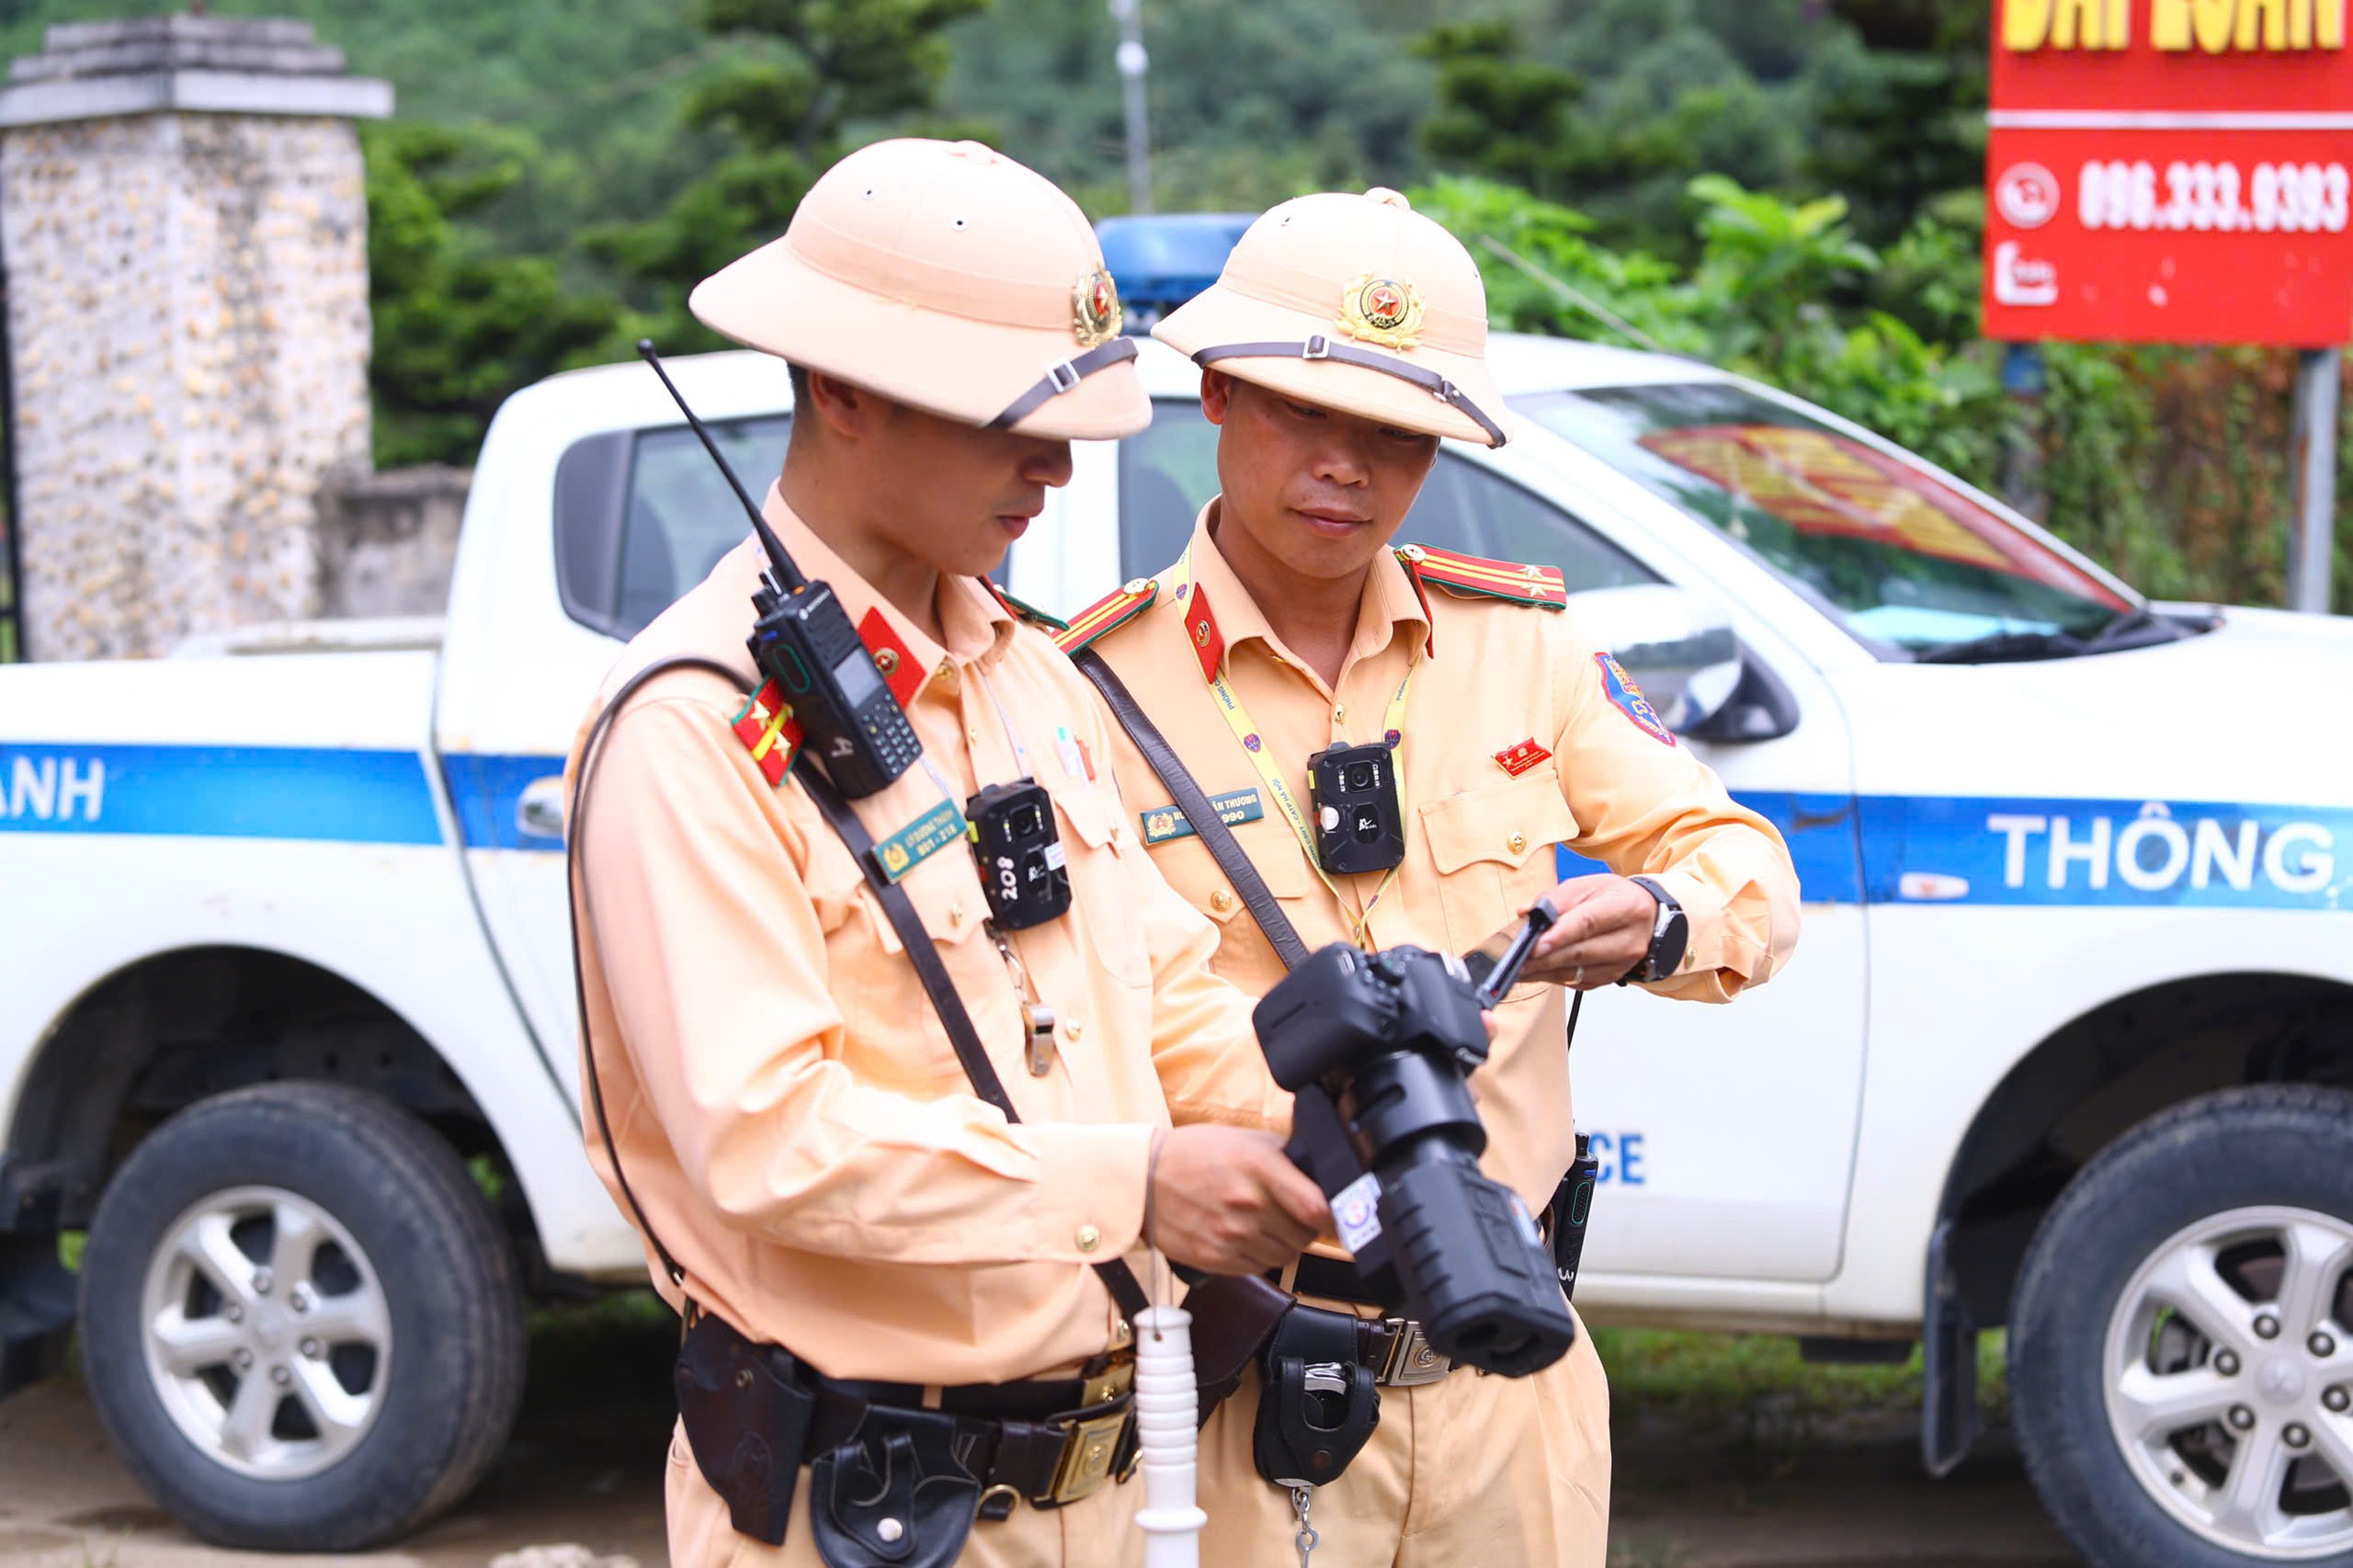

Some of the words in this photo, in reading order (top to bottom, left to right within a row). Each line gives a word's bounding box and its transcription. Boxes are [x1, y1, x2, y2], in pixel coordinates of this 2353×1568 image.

[0, 756, 106, 822] NH
[1221, 811, 1245, 824] 990
[1986, 801, 2336, 894] THÔNG
[996, 857, 1018, 902] 208
